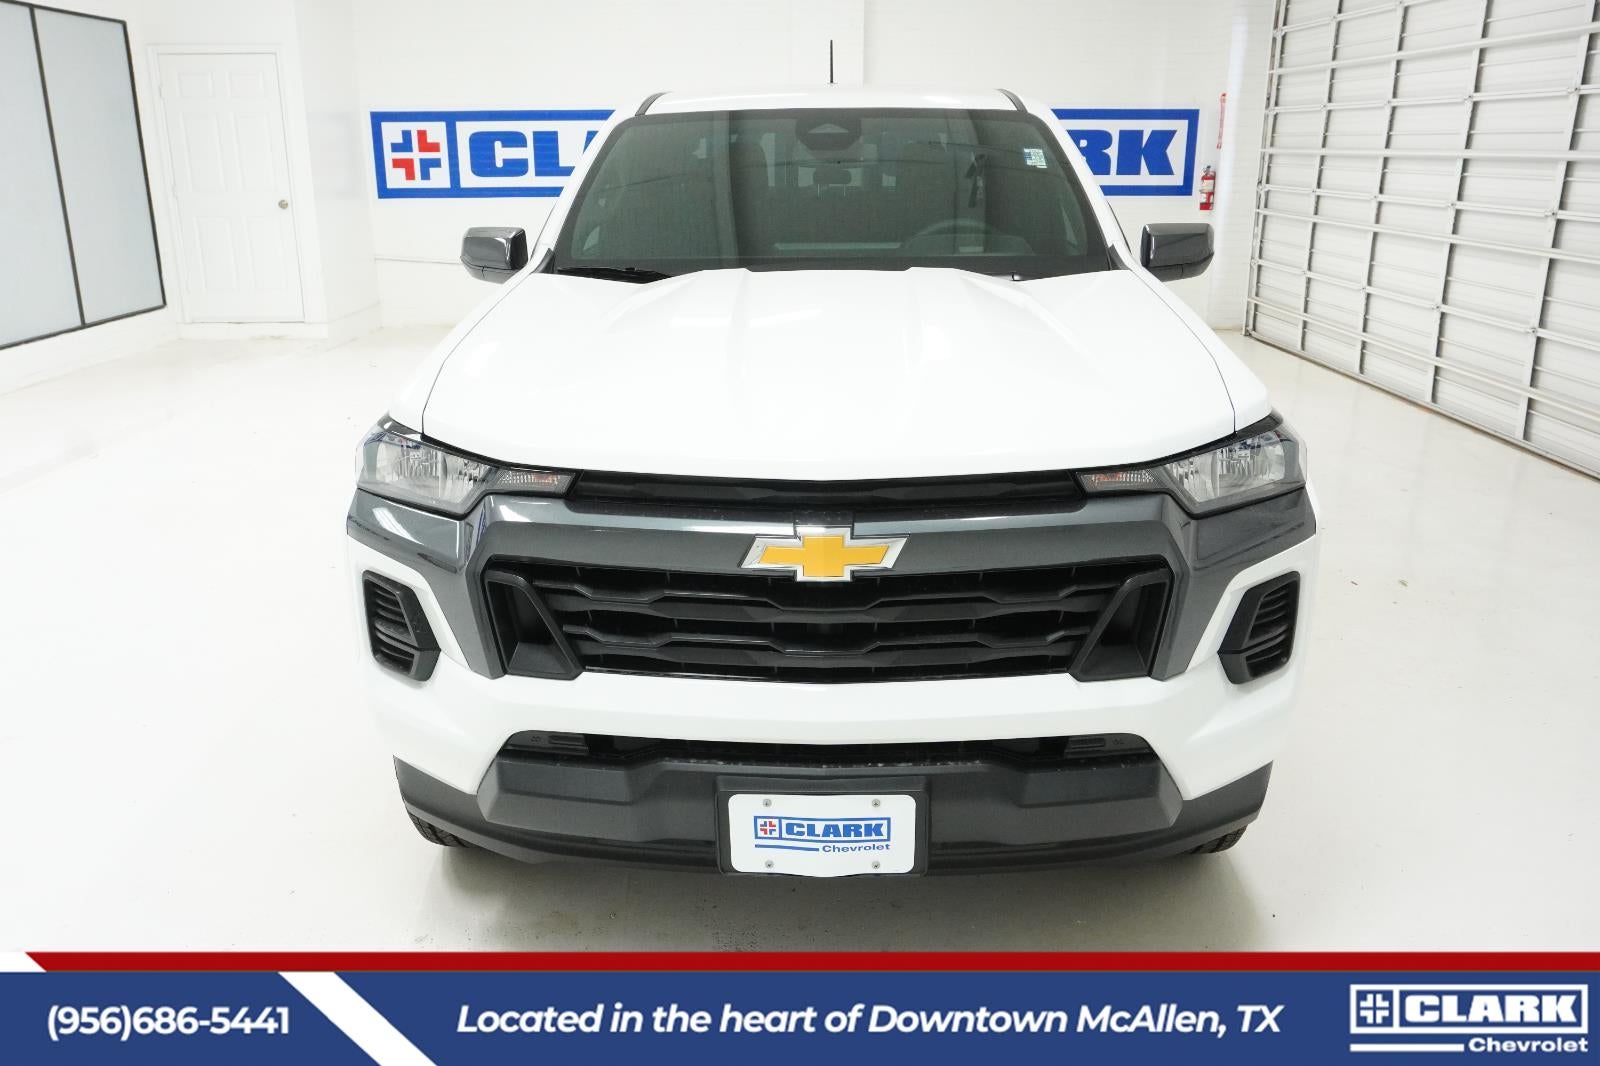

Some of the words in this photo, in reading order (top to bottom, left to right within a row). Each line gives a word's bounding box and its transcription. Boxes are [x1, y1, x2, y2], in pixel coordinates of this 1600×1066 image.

[469, 130, 599, 177] CL
[785, 822, 884, 838] CLARK
[822, 843, 891, 853] Chevrolet
